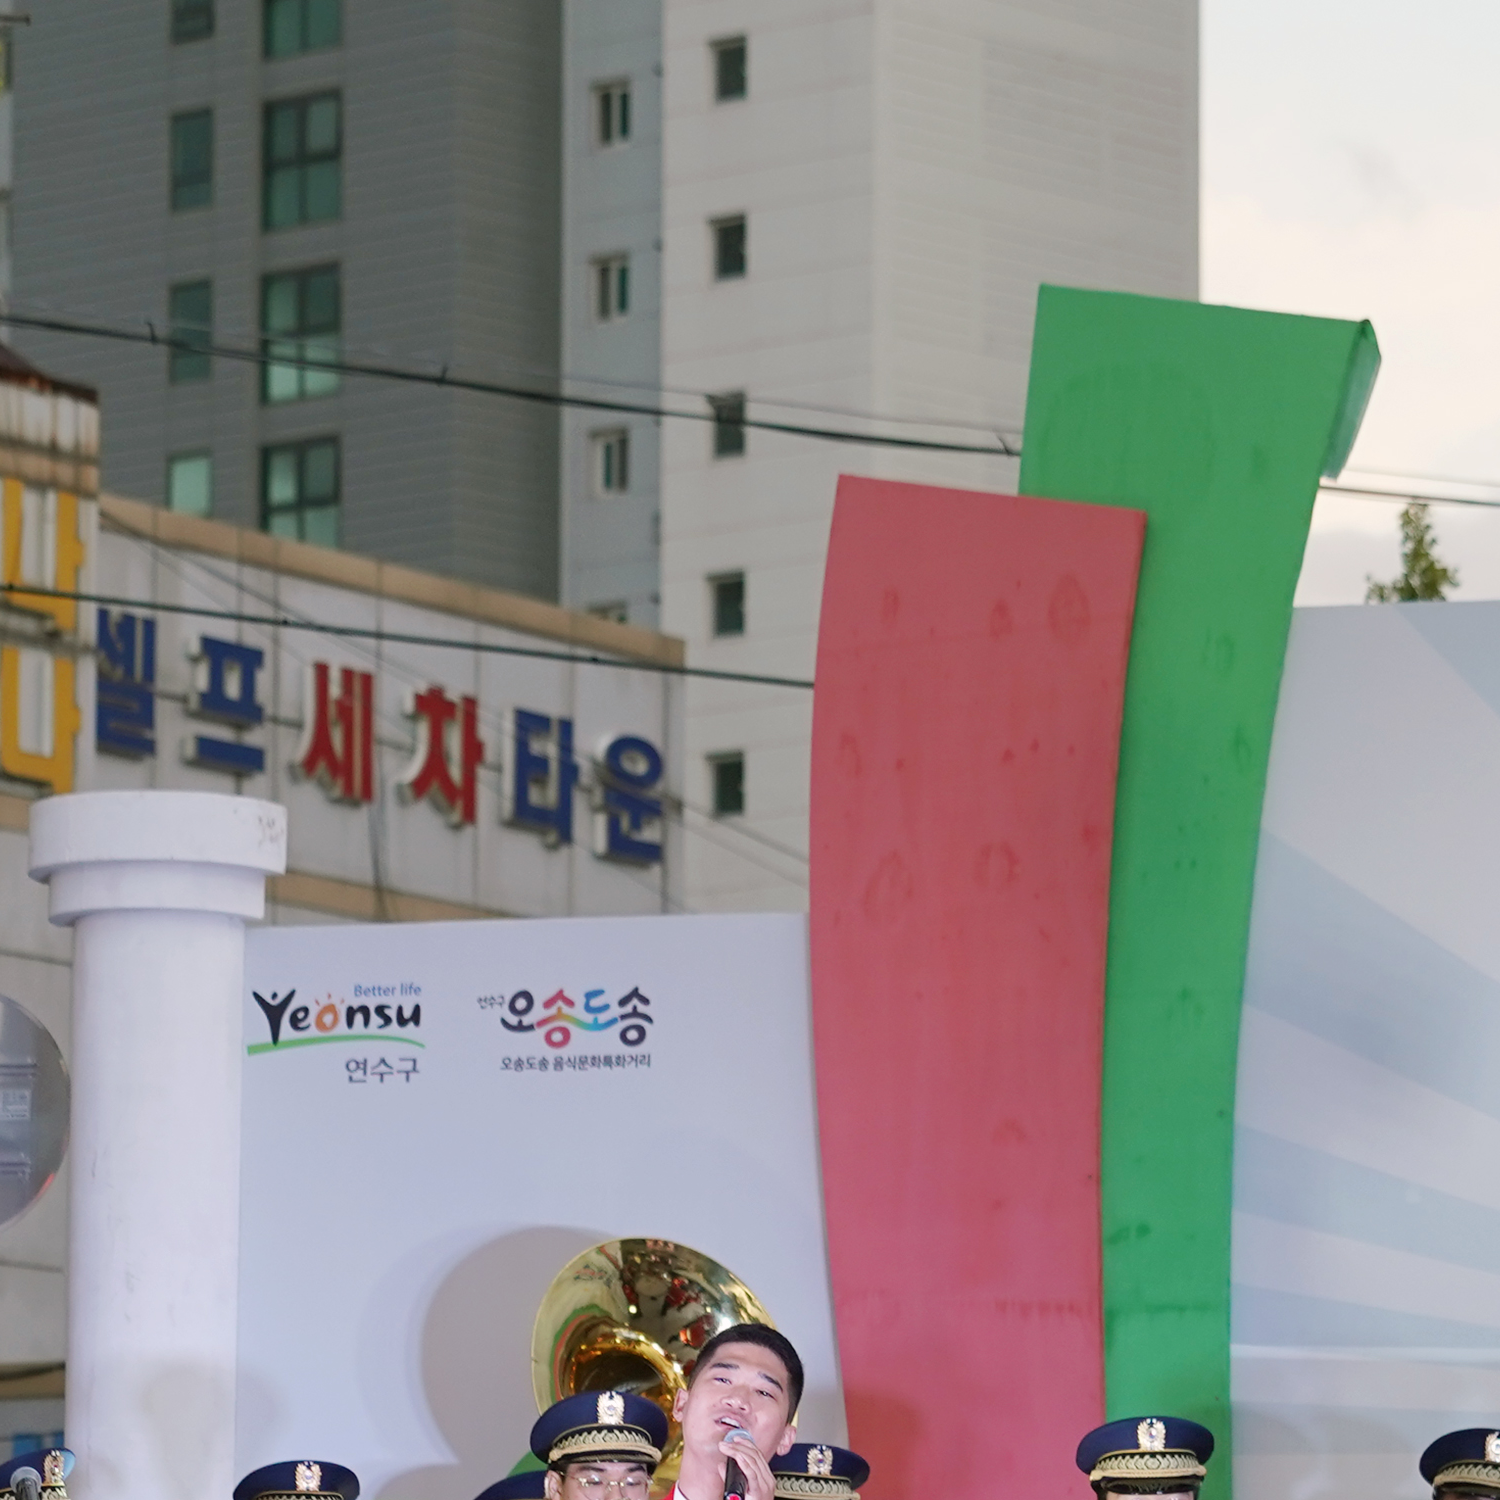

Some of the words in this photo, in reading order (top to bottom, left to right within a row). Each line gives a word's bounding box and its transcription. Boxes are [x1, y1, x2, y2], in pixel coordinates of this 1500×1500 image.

[354, 983, 397, 997] Better
[399, 982, 422, 997] life
[252, 988, 422, 1046] Yeonsu
[500, 986, 654, 1049] 오송도송
[345, 1057, 421, 1084] 연수구
[501, 1057, 549, 1072] 오송도송
[553, 1053, 652, 1071] 음식문화특화거리
